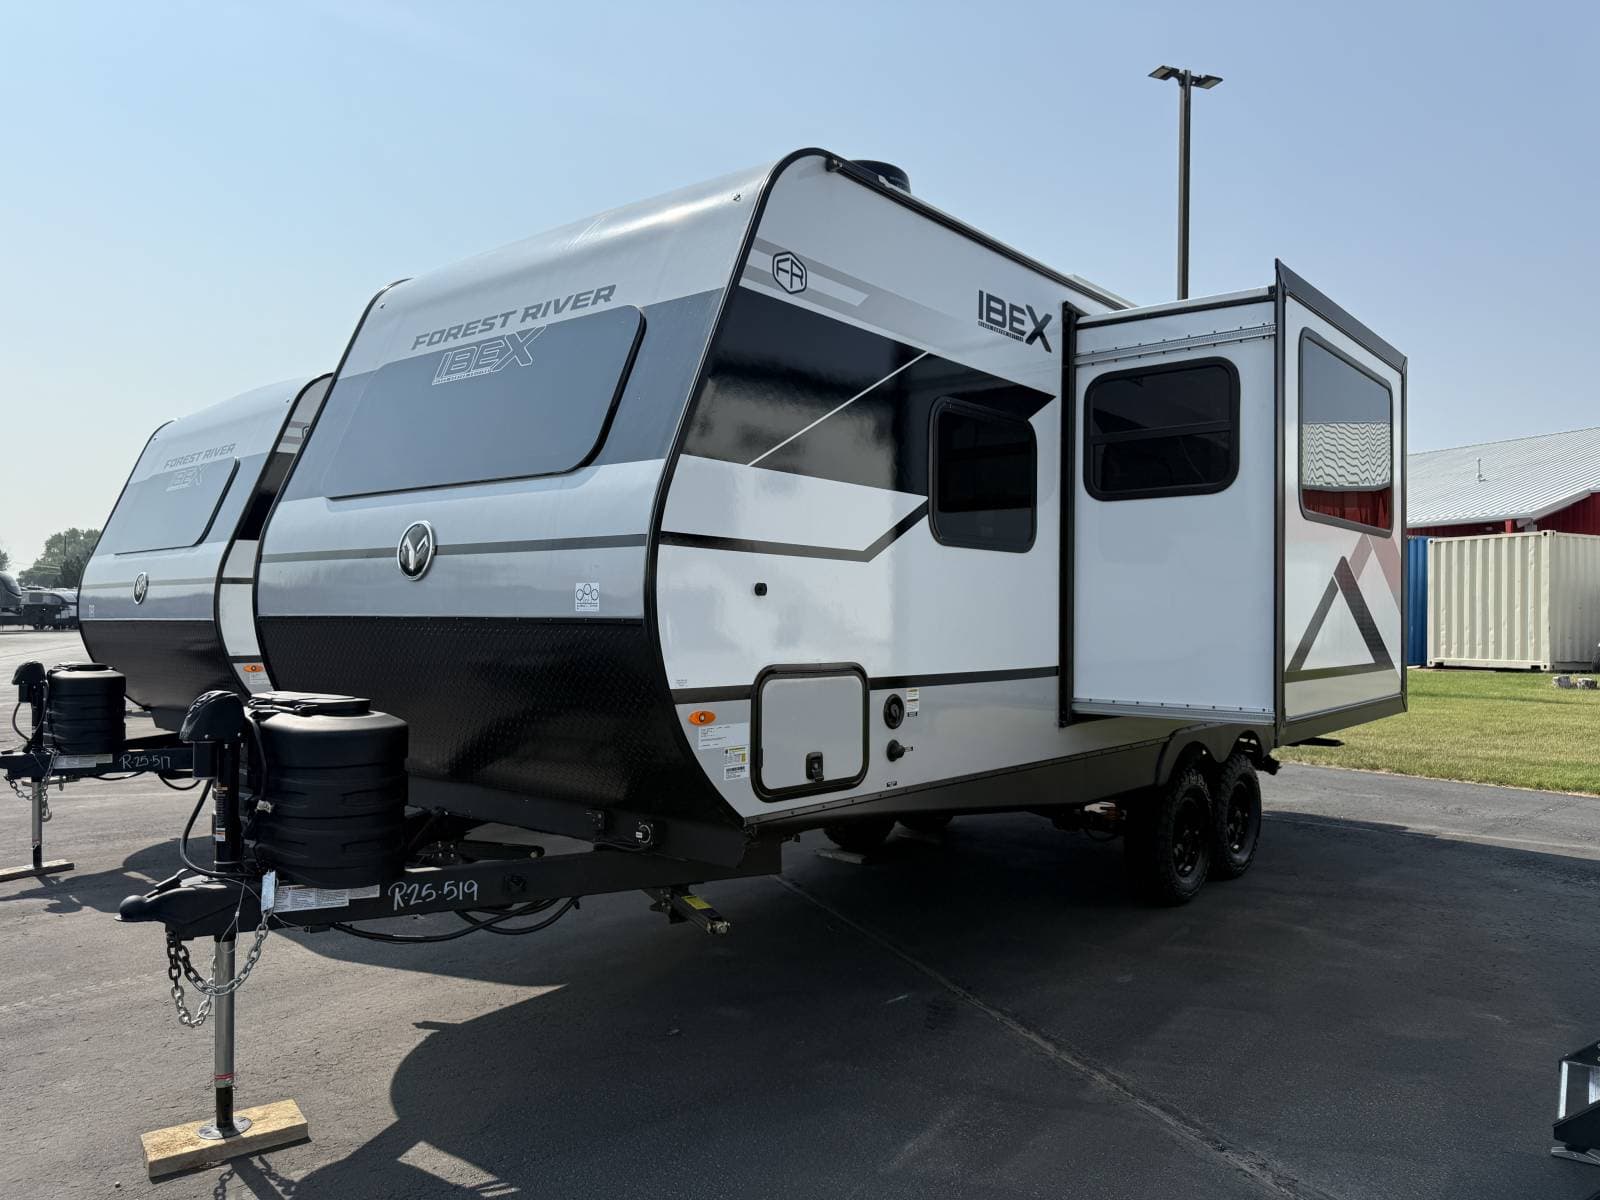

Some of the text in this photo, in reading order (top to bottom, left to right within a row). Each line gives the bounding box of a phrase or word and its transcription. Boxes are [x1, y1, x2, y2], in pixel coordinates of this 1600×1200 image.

[411, 284, 617, 350] FOREST RIVER
[978, 289, 1053, 353] IBEX
[434, 324, 547, 379] IBEX
[164, 443, 236, 469] FOREST RIVER
